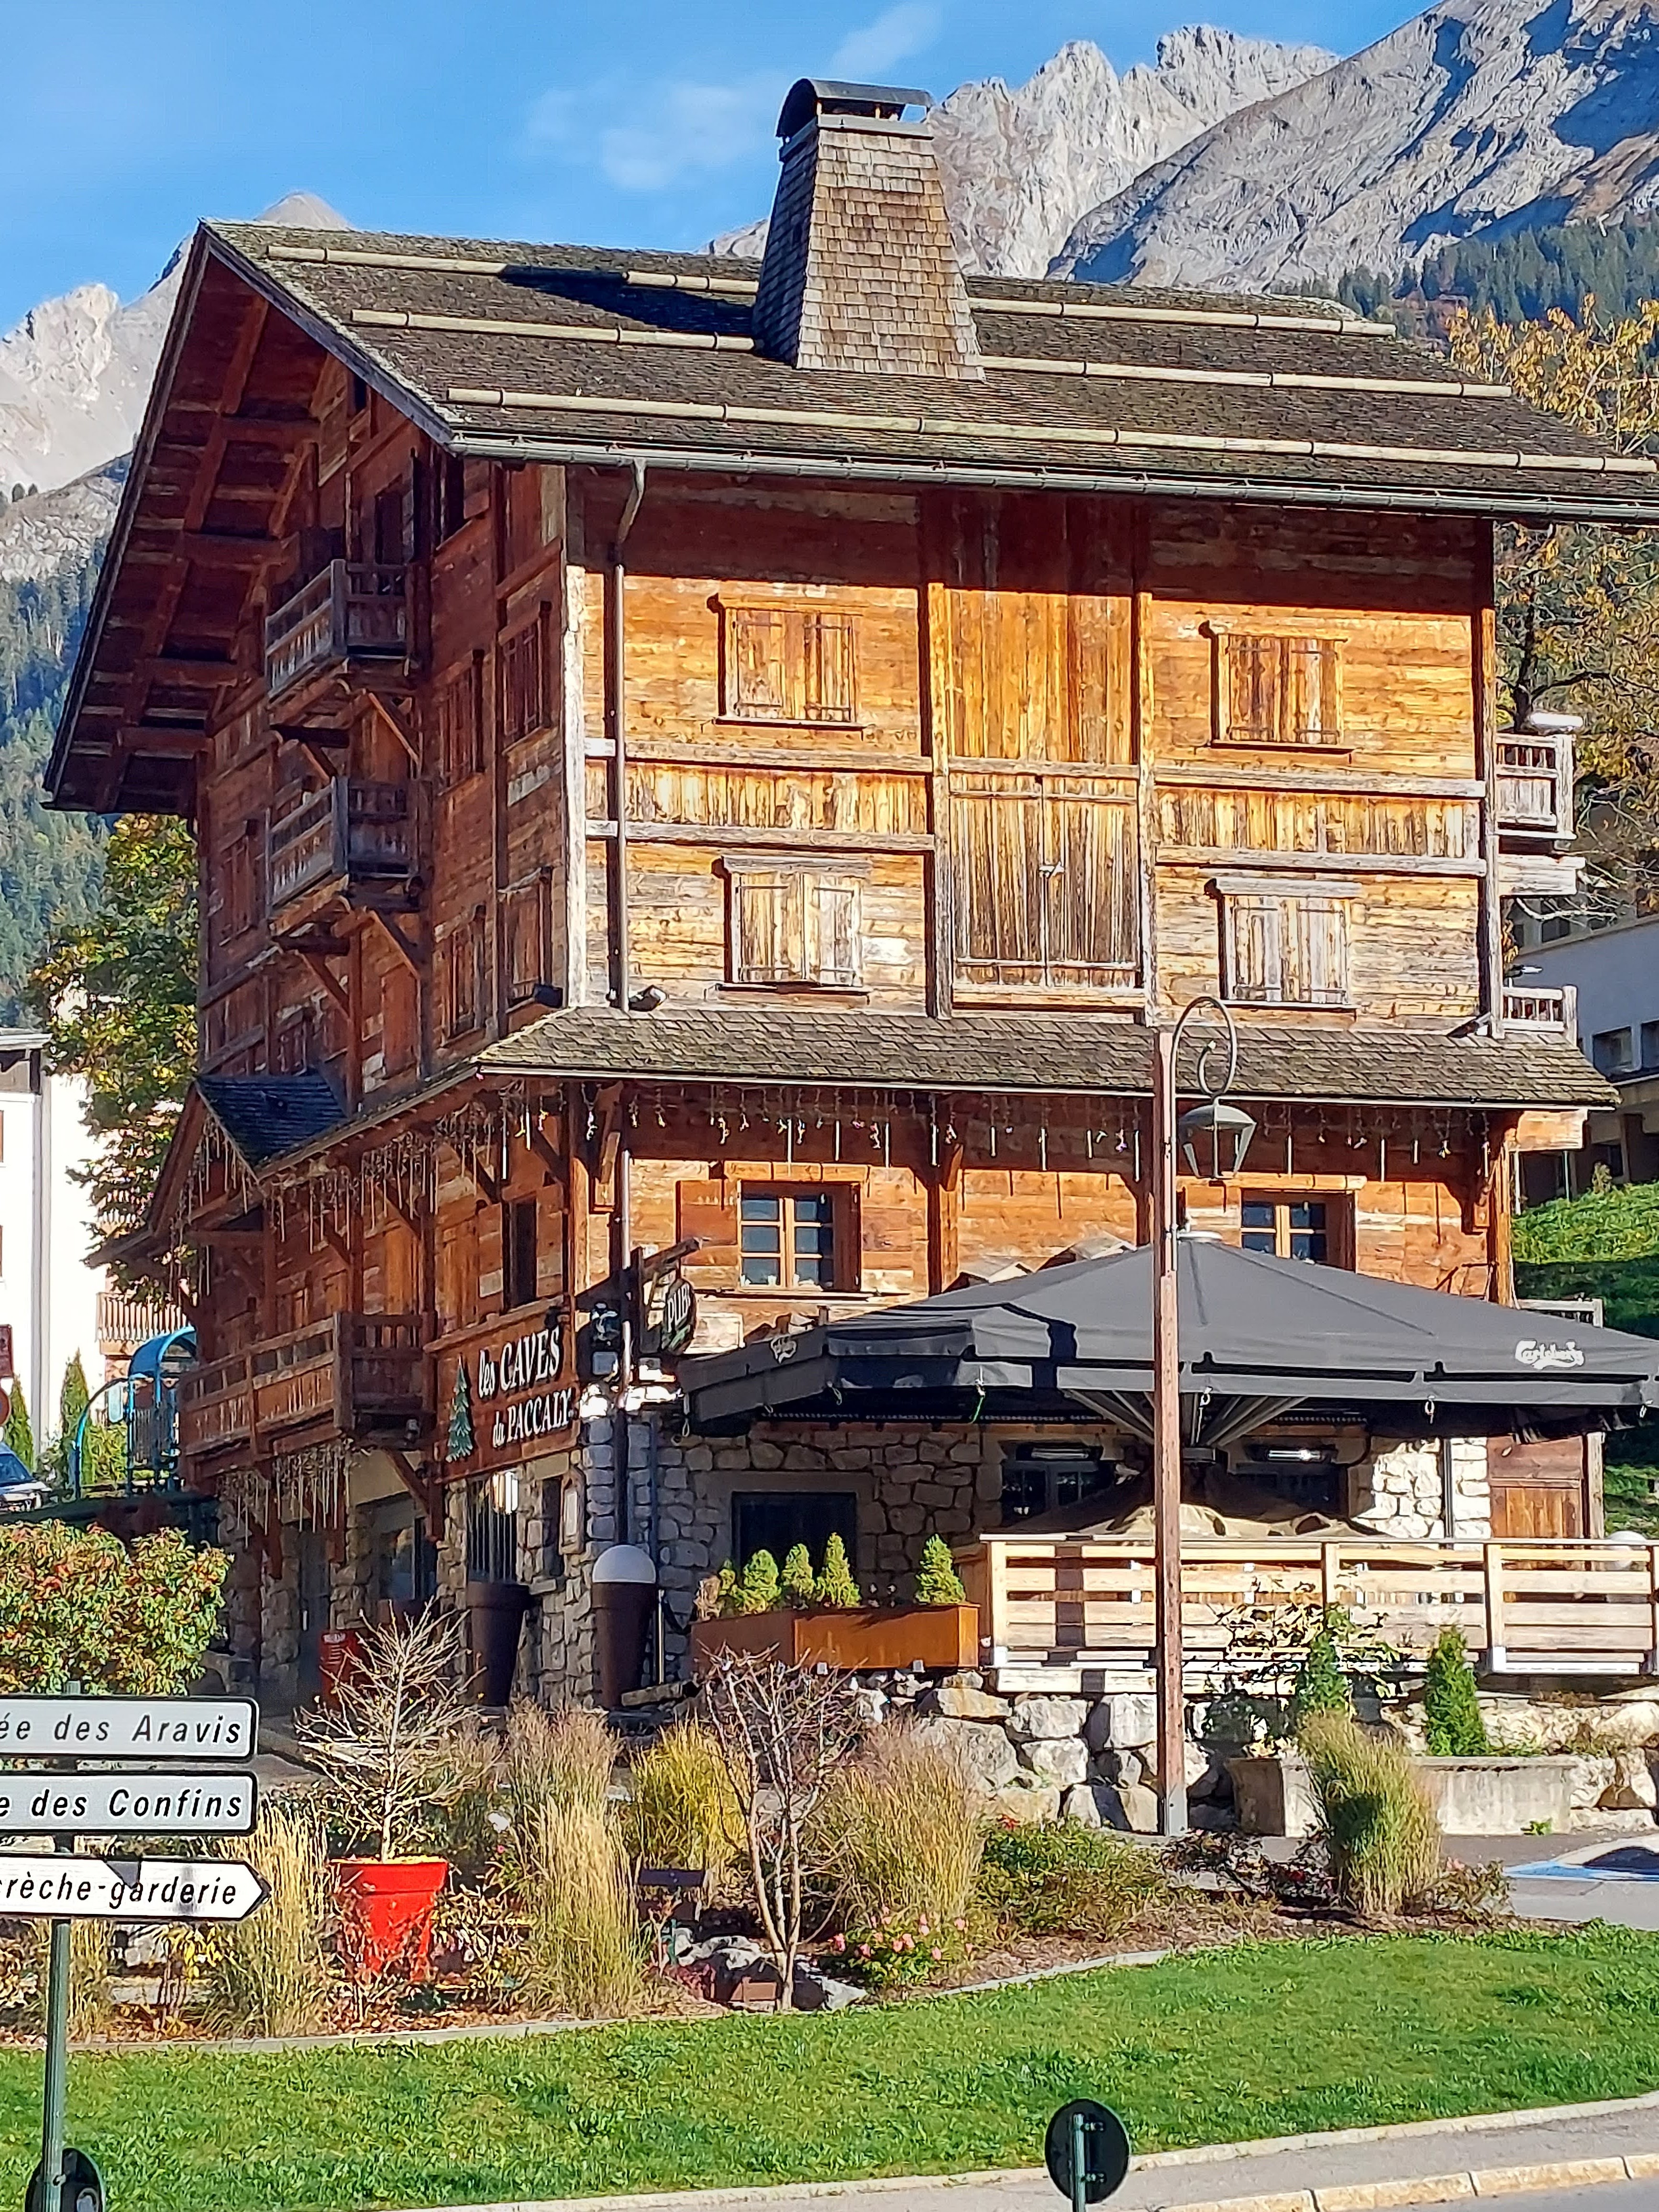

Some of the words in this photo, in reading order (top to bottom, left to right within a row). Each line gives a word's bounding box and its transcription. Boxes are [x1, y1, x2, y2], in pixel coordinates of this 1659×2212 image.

[668, 1283, 691, 1333] PUB
[479, 1349, 496, 1398] les
[500, 1325, 560, 1391] CAVES
[493, 1411, 506, 1448] du
[507, 1387, 572, 1443] PACCALY
[54, 1714, 110, 1741] des
[132, 1715, 241, 1744] Aravis
[31, 1789, 87, 1817] des
[109, 1789, 242, 1818] Confins
[0, 1871, 236, 1909] rèche-garderie
